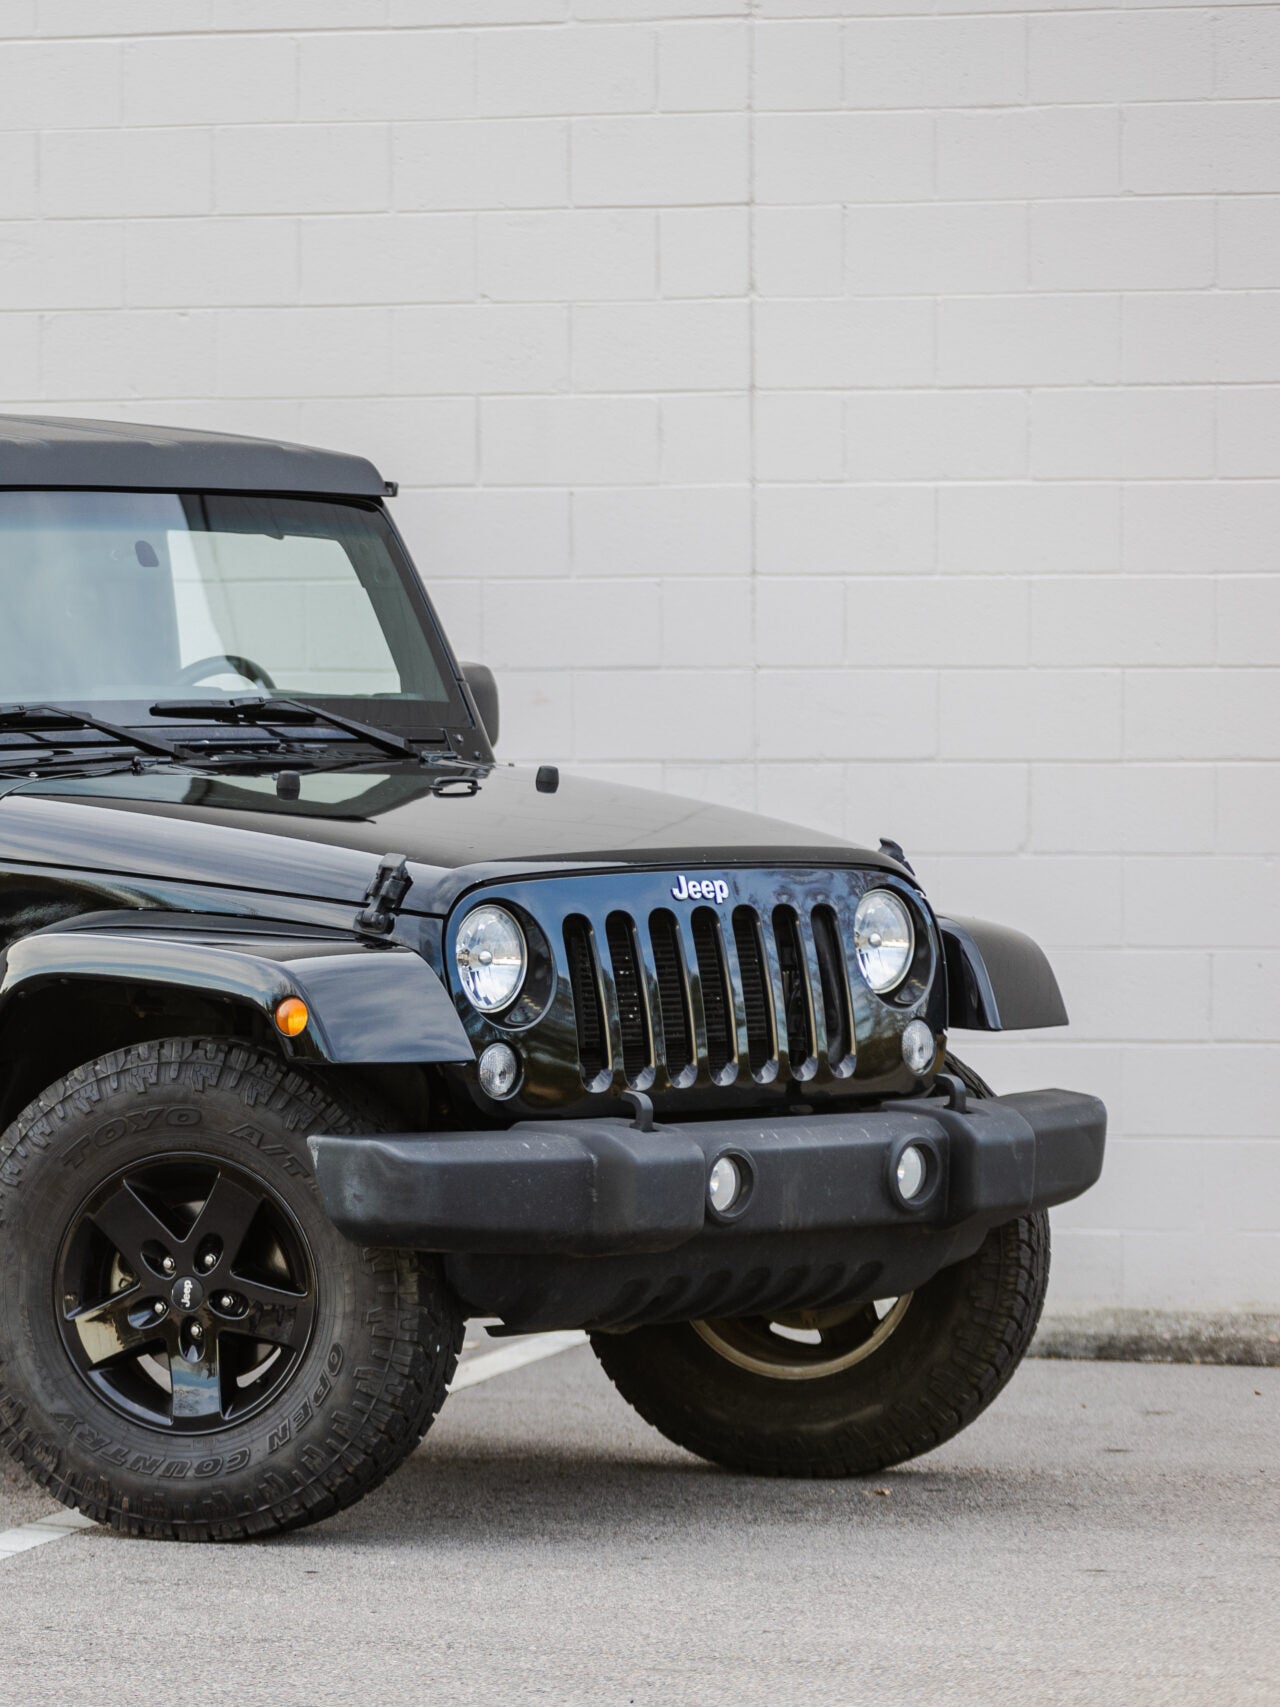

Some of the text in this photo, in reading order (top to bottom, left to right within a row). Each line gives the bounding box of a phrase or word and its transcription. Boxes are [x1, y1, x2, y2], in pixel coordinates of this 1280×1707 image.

[672, 875, 729, 904] Jeep
[61, 1107, 202, 1169] TOYO
[228, 1123, 311, 1180] A/T
[181, 1280, 193, 1307] Jeep
[50, 1343, 344, 1479] OPEN COUNTRY
